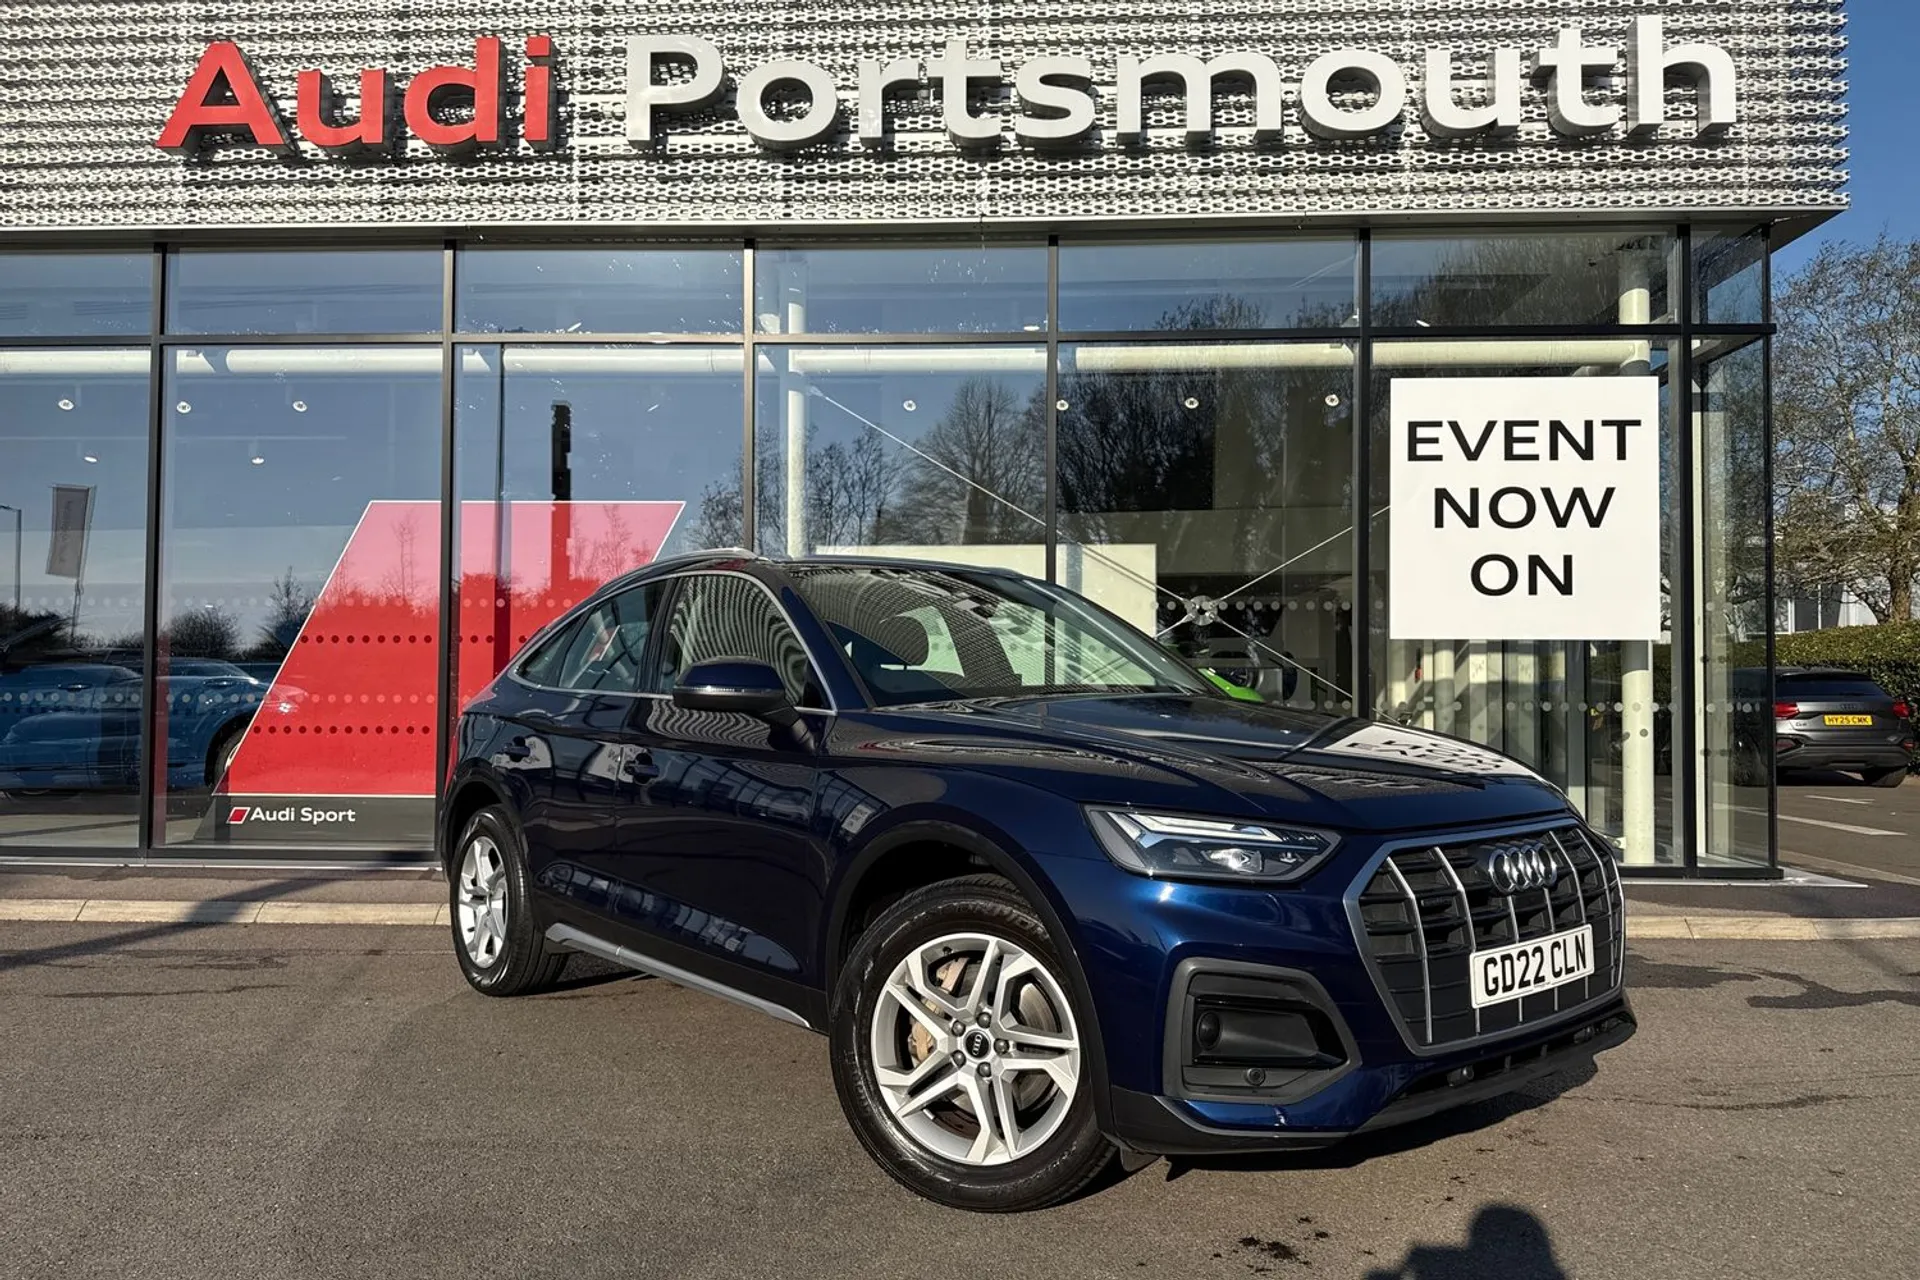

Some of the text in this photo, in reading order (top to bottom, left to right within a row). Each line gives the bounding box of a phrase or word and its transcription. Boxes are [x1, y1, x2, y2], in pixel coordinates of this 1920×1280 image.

[156, 14, 1738, 149] Audi Portsmouth
[1407, 419, 1643, 462] EVENT
[1434, 486, 1617, 529] NOW
[1470, 553, 1574, 597] ON
[250, 806, 357, 826] Audi Sport
[1483, 932, 1588, 997] GD22 CLN
